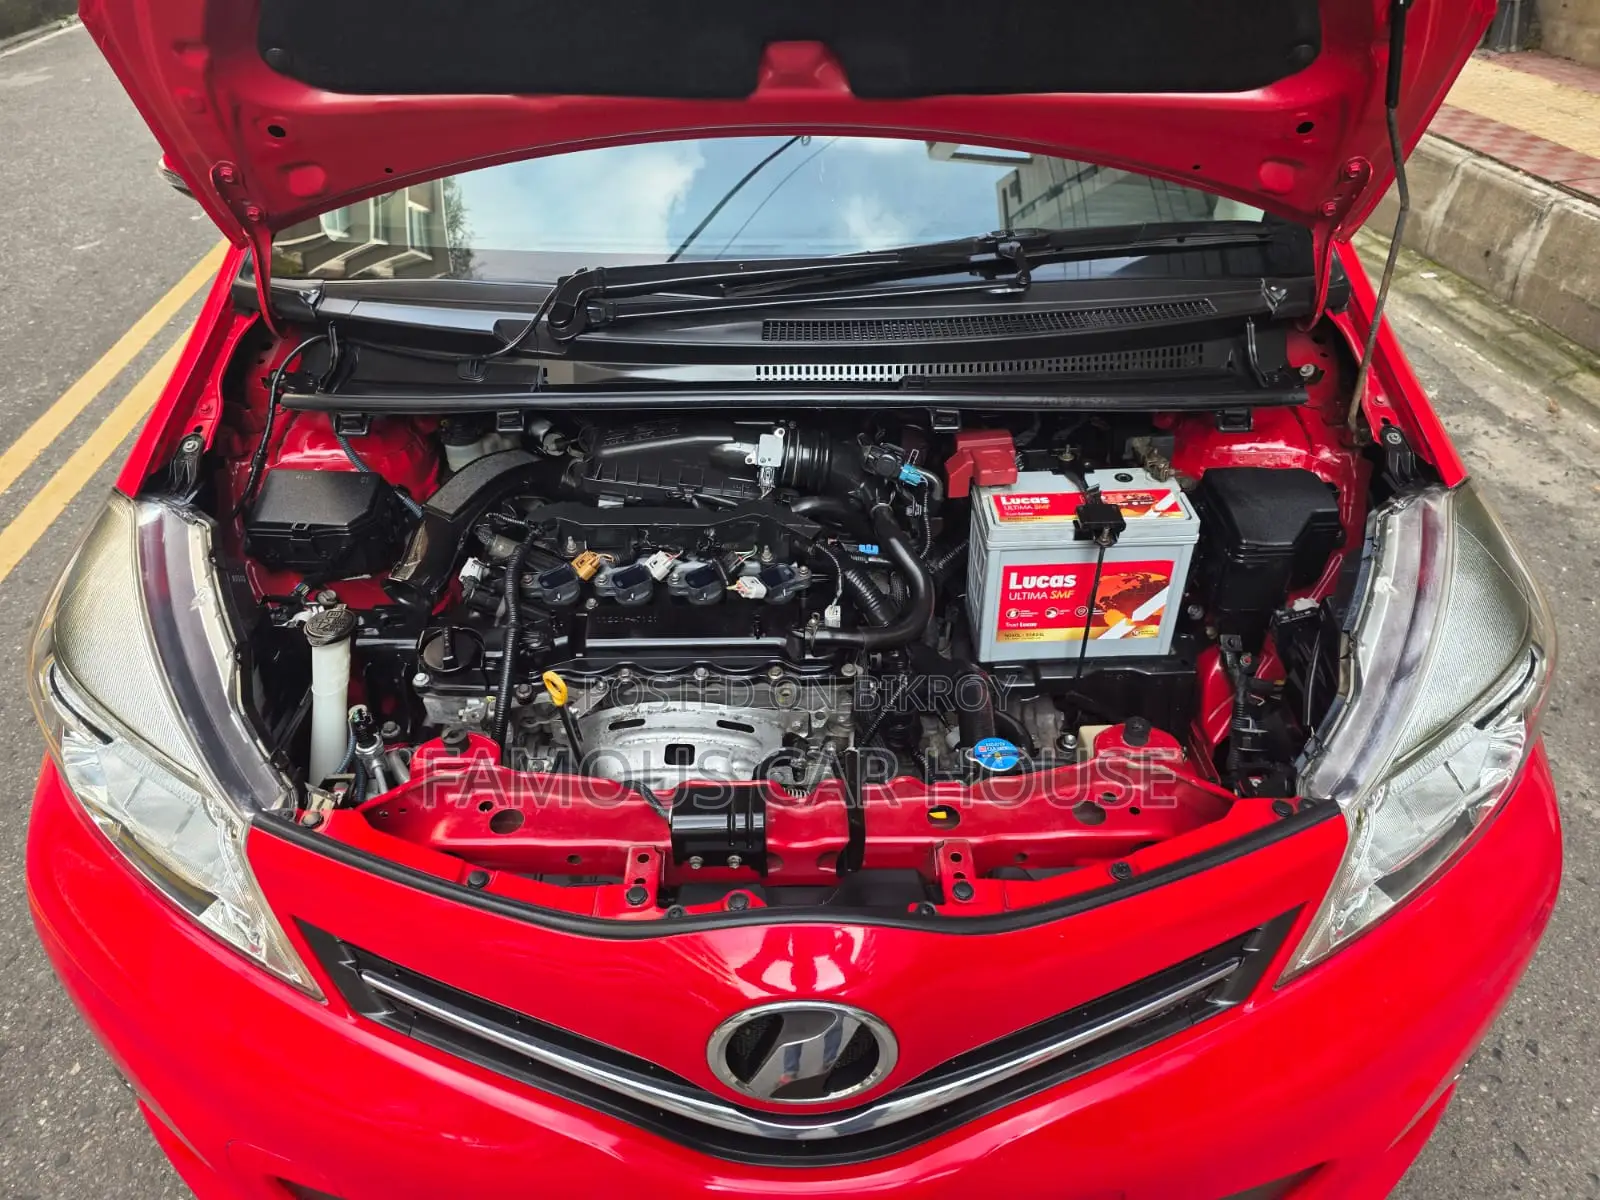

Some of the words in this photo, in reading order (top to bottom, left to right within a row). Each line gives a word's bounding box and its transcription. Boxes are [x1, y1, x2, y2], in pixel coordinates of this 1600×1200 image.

[1000, 496, 1050, 505] Lucas
[1009, 572, 1077, 590] Lucas
[1008, 591, 1048, 601] ULTIMA
[1050, 590, 1075, 599] SMF
